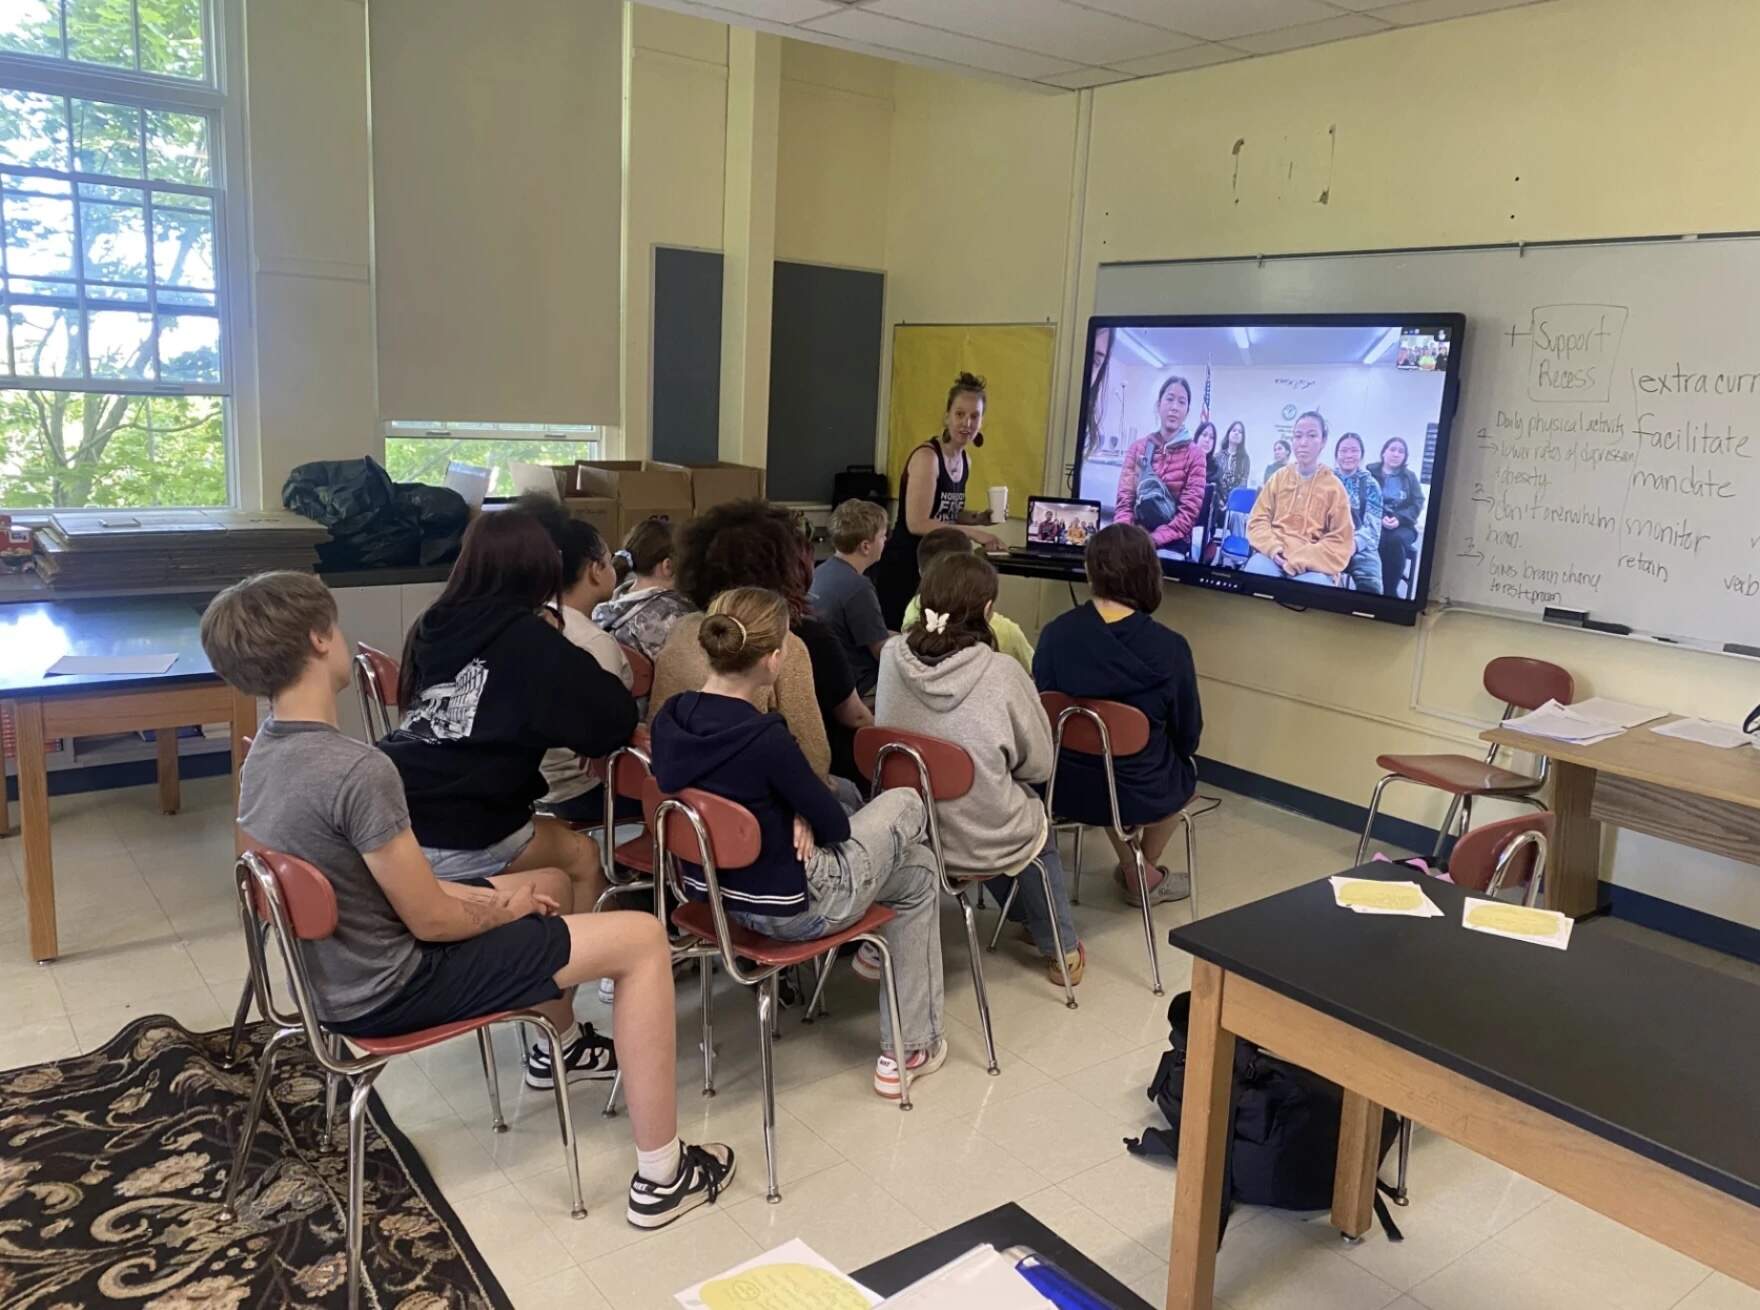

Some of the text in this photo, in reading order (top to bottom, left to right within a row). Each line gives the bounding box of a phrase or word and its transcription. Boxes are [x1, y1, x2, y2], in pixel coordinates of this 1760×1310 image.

[1534, 313, 1612, 361] Support
[1631, 412, 1753, 458] facilitate
[1632, 464, 1737, 498] mandate
[1625, 518, 1712, 554] monitor
[1617, 551, 1669, 583] retain
